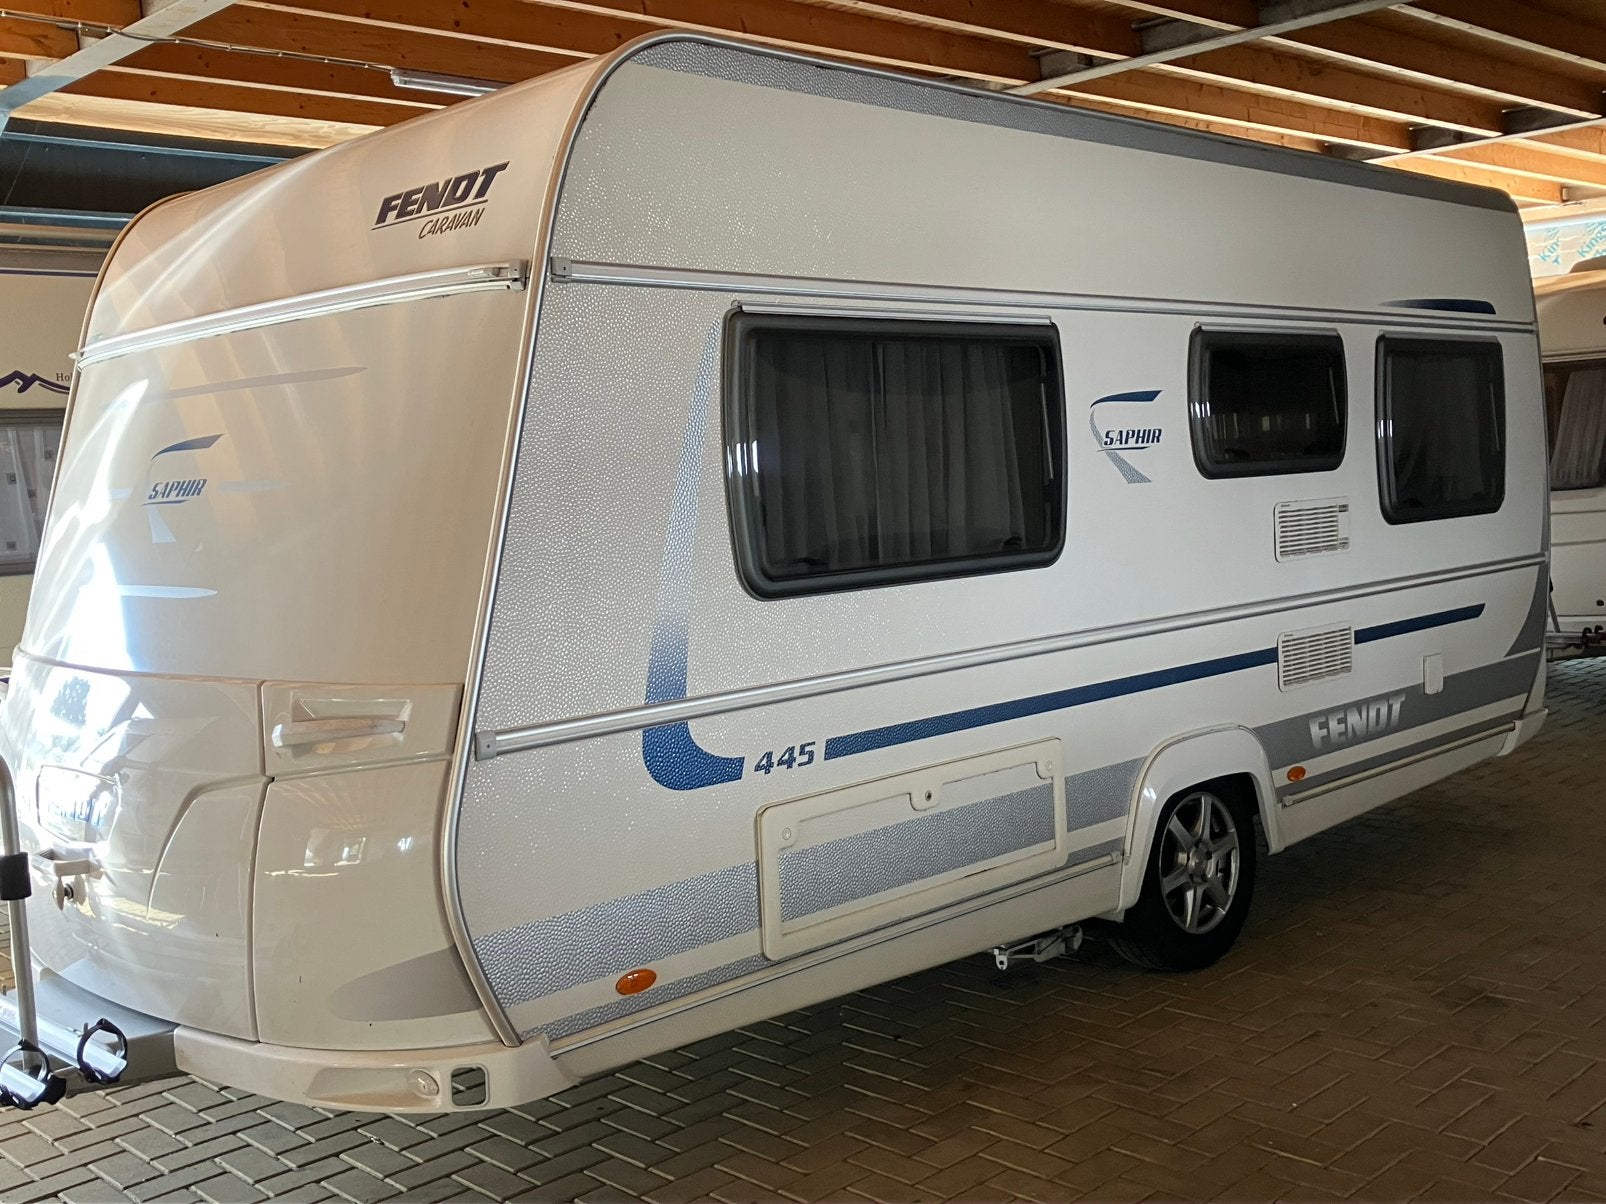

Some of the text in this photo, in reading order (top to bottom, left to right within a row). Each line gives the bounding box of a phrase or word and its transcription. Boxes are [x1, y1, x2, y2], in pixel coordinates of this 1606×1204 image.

[375, 160, 510, 225] FENDT
[418, 207, 485, 240] CARAVAN
[1103, 428, 1162, 446] SAPHIR
[148, 479, 207, 500] SAPHIR
[1308, 692, 1406, 749] FENDT
[753, 740, 816, 775] 445
